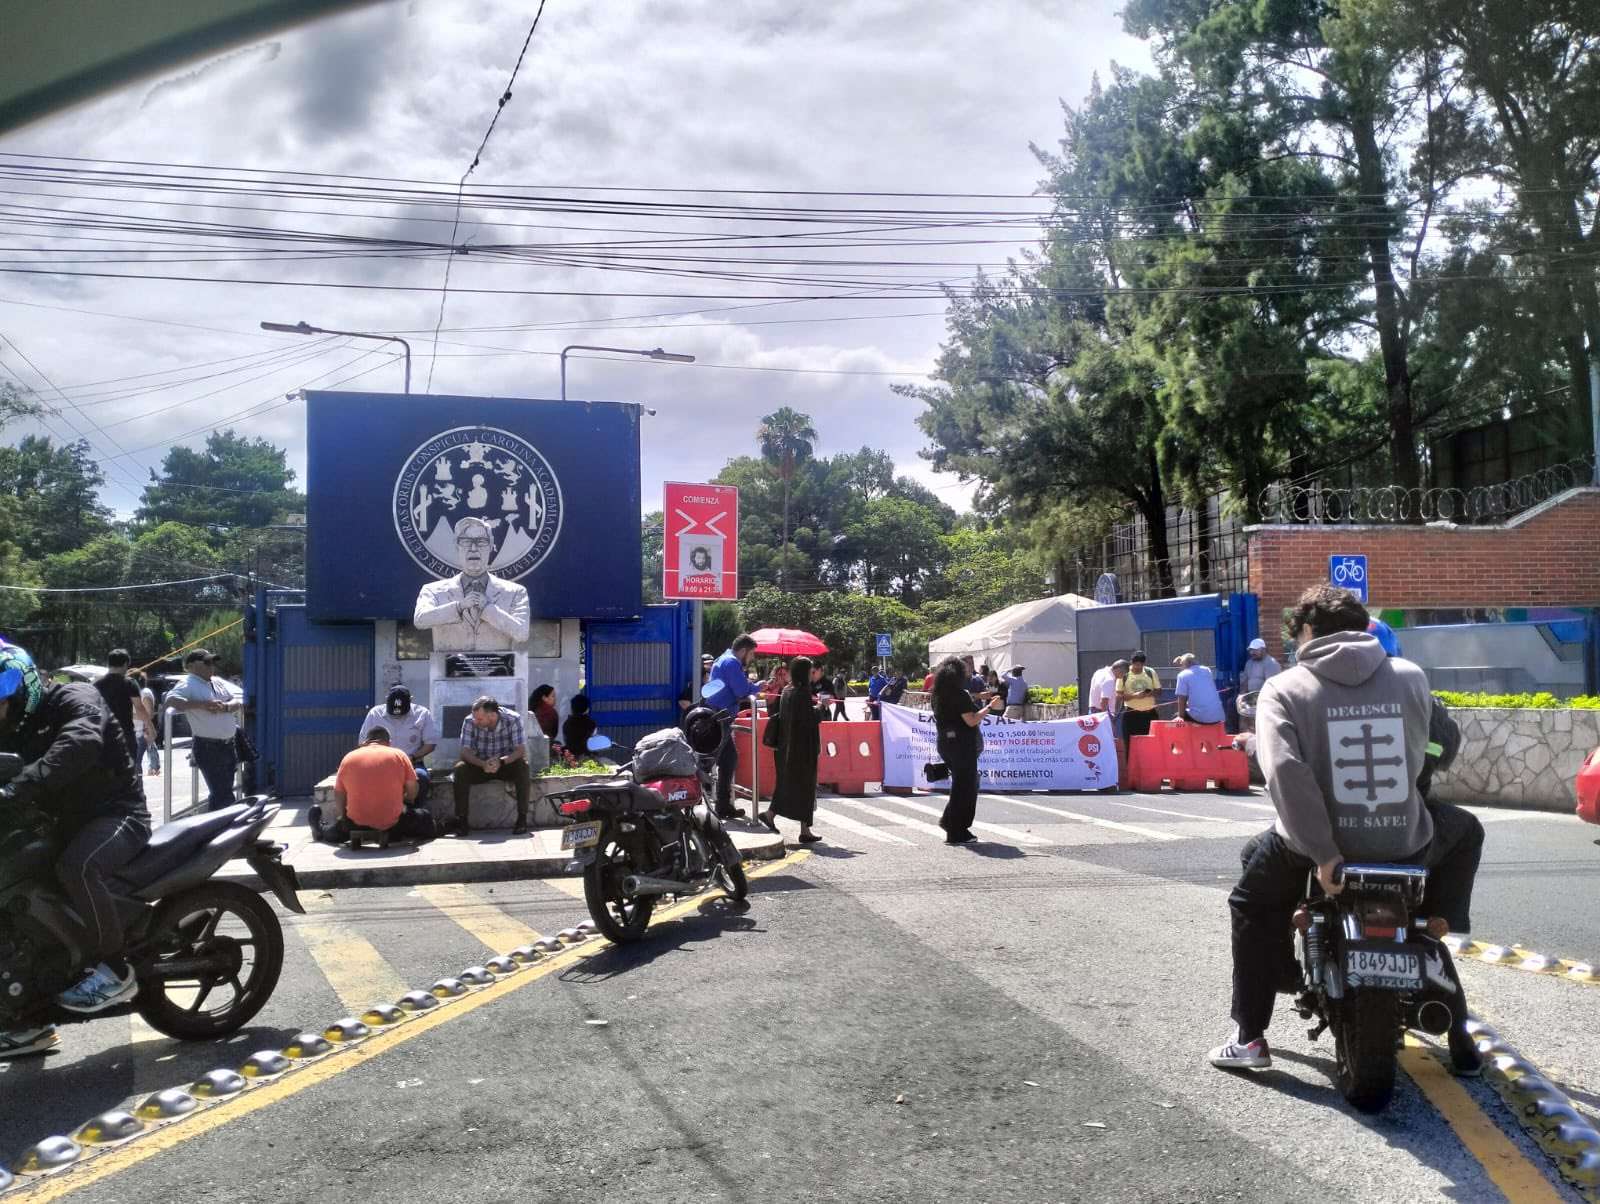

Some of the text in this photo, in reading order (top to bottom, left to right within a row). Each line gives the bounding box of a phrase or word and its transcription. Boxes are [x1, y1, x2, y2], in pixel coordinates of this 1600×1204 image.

[429, 559, 462, 578] NTER
[1327, 703, 1402, 718] DEGESCH
[990, 769, 1054, 778] INCREMENTO!
[1338, 815, 1408, 828] BE SAFE!
[1364, 975, 1424, 989] SUZUKI
